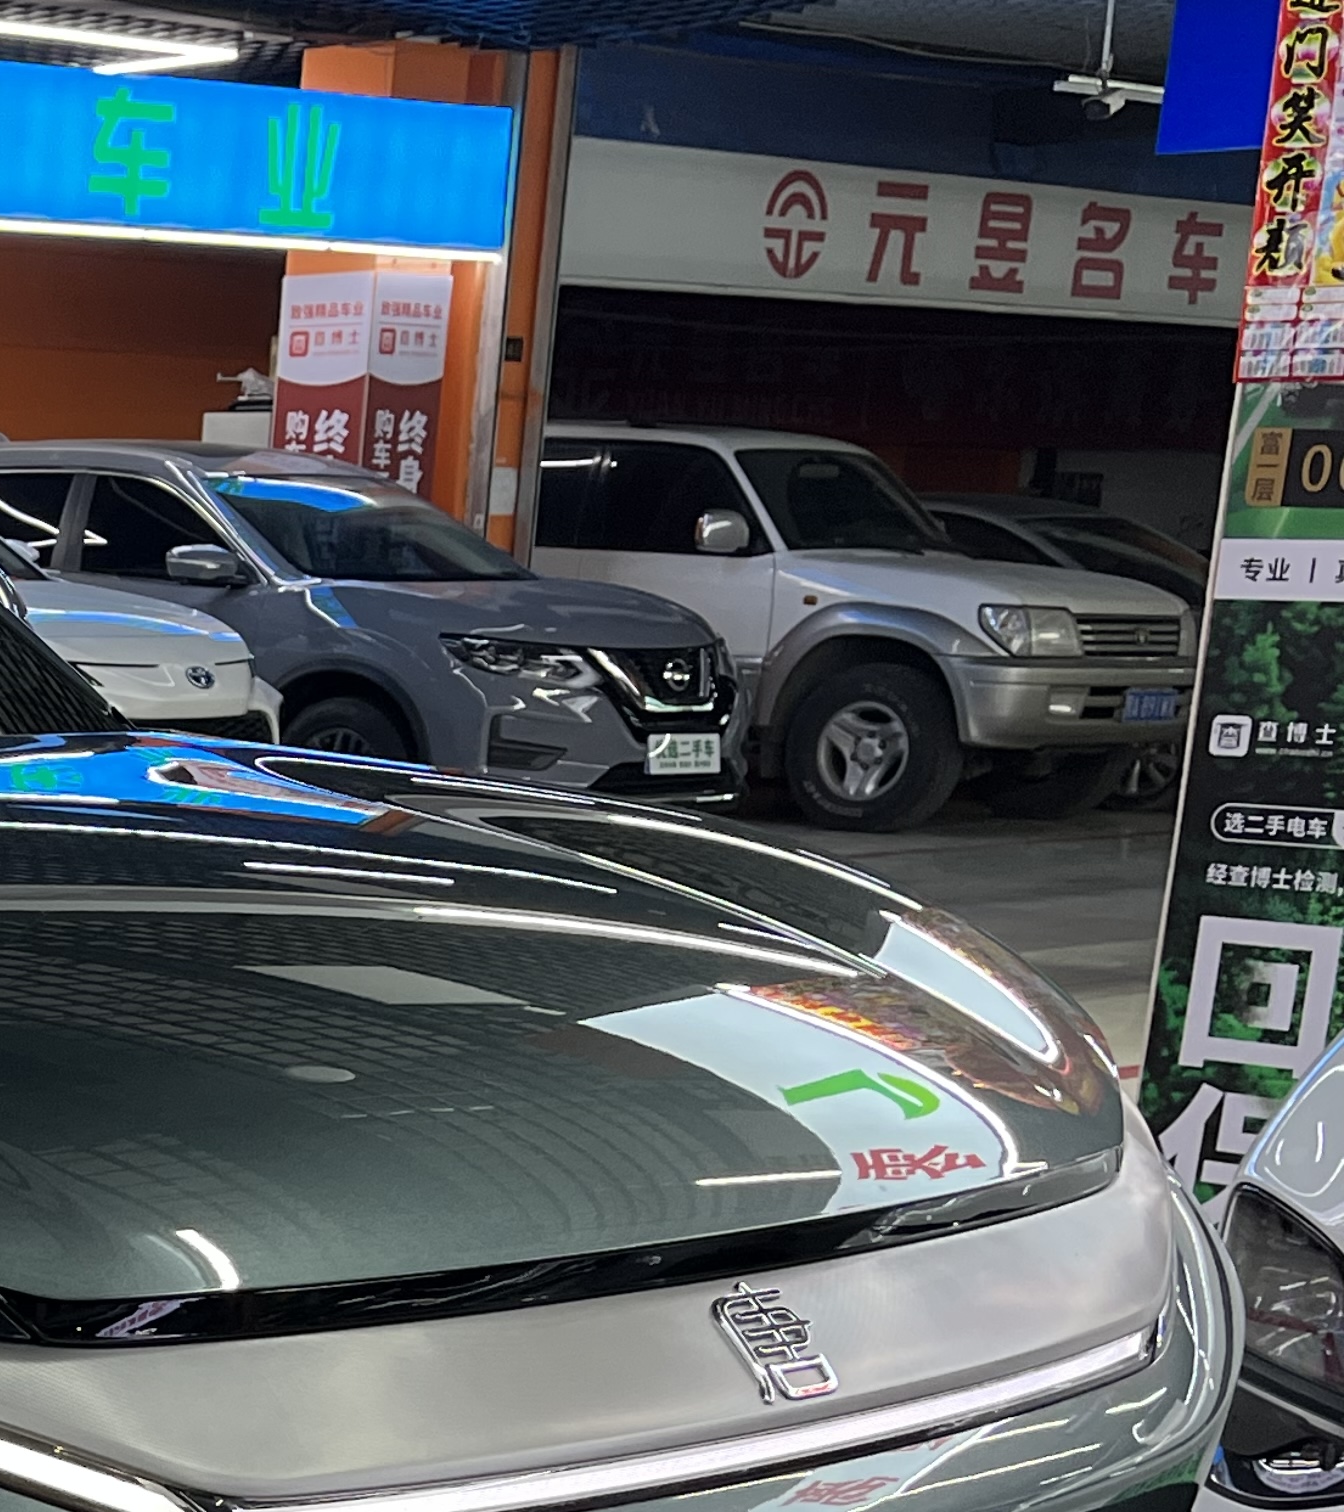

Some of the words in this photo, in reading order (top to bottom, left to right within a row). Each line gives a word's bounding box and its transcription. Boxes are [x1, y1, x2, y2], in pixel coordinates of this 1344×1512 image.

[1255, 0, 1340, 271] 门笑开颜
[865, 181, 1224, 305] 元昱名车
[1240, 556, 1291, 583] 专业
[1223, 811, 1329, 840] 选二手电车
